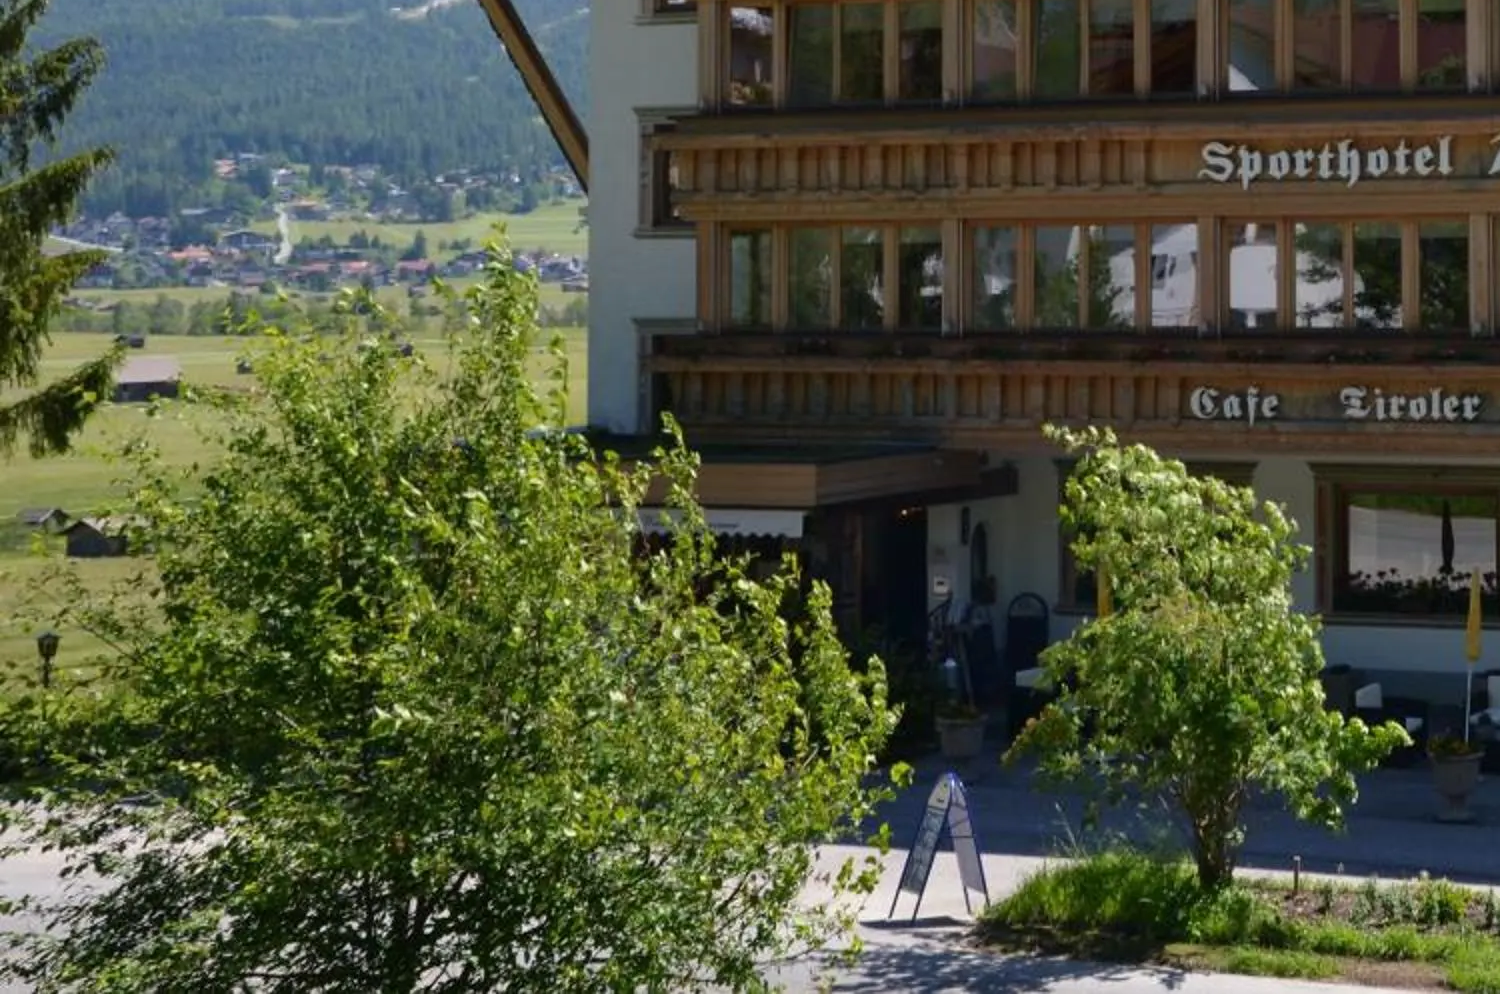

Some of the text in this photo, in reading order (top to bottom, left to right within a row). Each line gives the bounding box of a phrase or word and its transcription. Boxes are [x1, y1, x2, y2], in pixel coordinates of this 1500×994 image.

[1197, 135, 1454, 190] Sporthotel
[1190, 385, 1280, 427] Cafe
[1340, 387, 1481, 420] Tiroler
